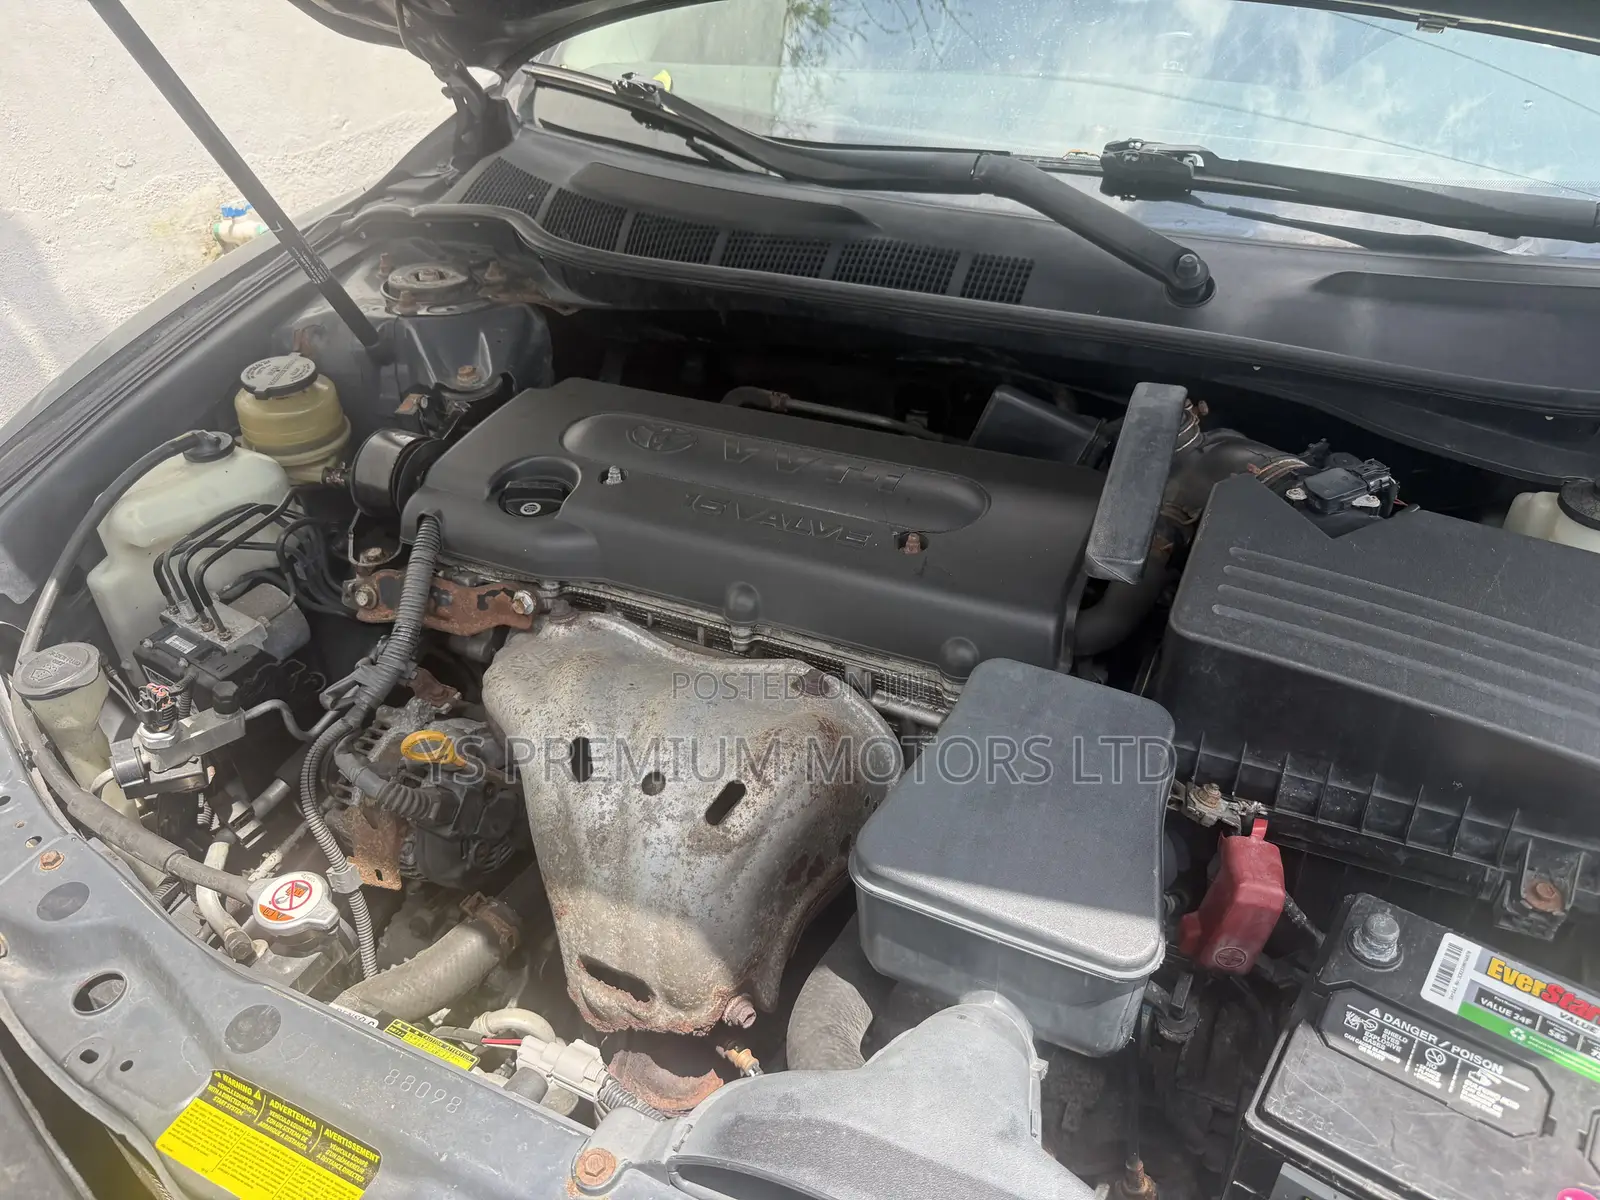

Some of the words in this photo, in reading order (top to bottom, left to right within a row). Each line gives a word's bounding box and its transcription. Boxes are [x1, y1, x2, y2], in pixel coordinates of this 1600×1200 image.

[1486, 956, 1600, 1028] EverStar
[1478, 996, 1513, 1017] VALUE
[1512, 1012, 1533, 1026] 24F
[1558, 1011, 1598, 1034] VALUE
[1361, 1035, 1386, 1050] GASES
[1363, 1030, 1402, 1052] EXPLOSIVE
[1382, 1012, 1438, 1044] DANGER
[1438, 1038, 1451, 1050] /
[1449, 1043, 1505, 1075] POISON
[220, 1073, 254, 1095] WARNING
[381, 1065, 464, 1115] 88098
[268, 1098, 318, 1130] ADVERTENCIA
[323, 1127, 380, 1163] AVERTISSEMENT
